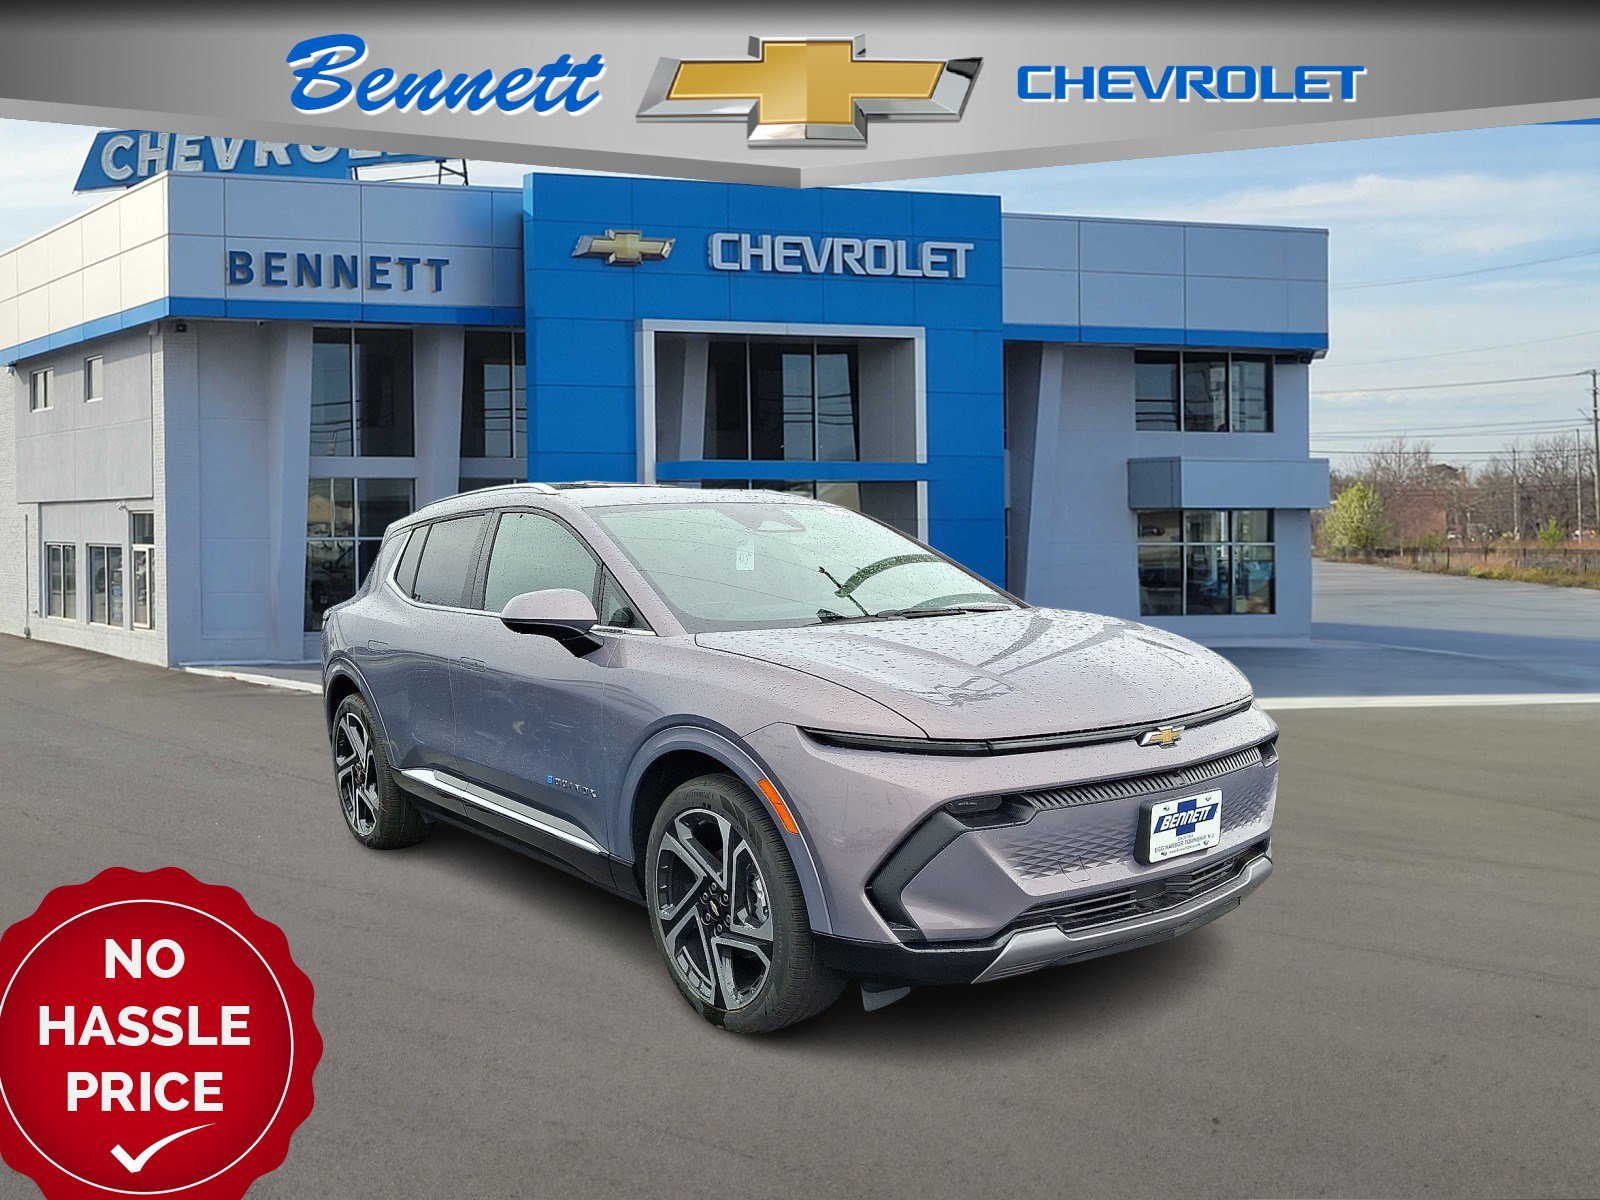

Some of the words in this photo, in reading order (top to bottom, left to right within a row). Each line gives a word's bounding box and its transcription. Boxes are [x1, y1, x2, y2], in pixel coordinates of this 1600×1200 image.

[226, 250, 450, 293] BENNETT
[708, 232, 975, 279] CHEVROLET
[1160, 805, 1212, 831] BENNETT
